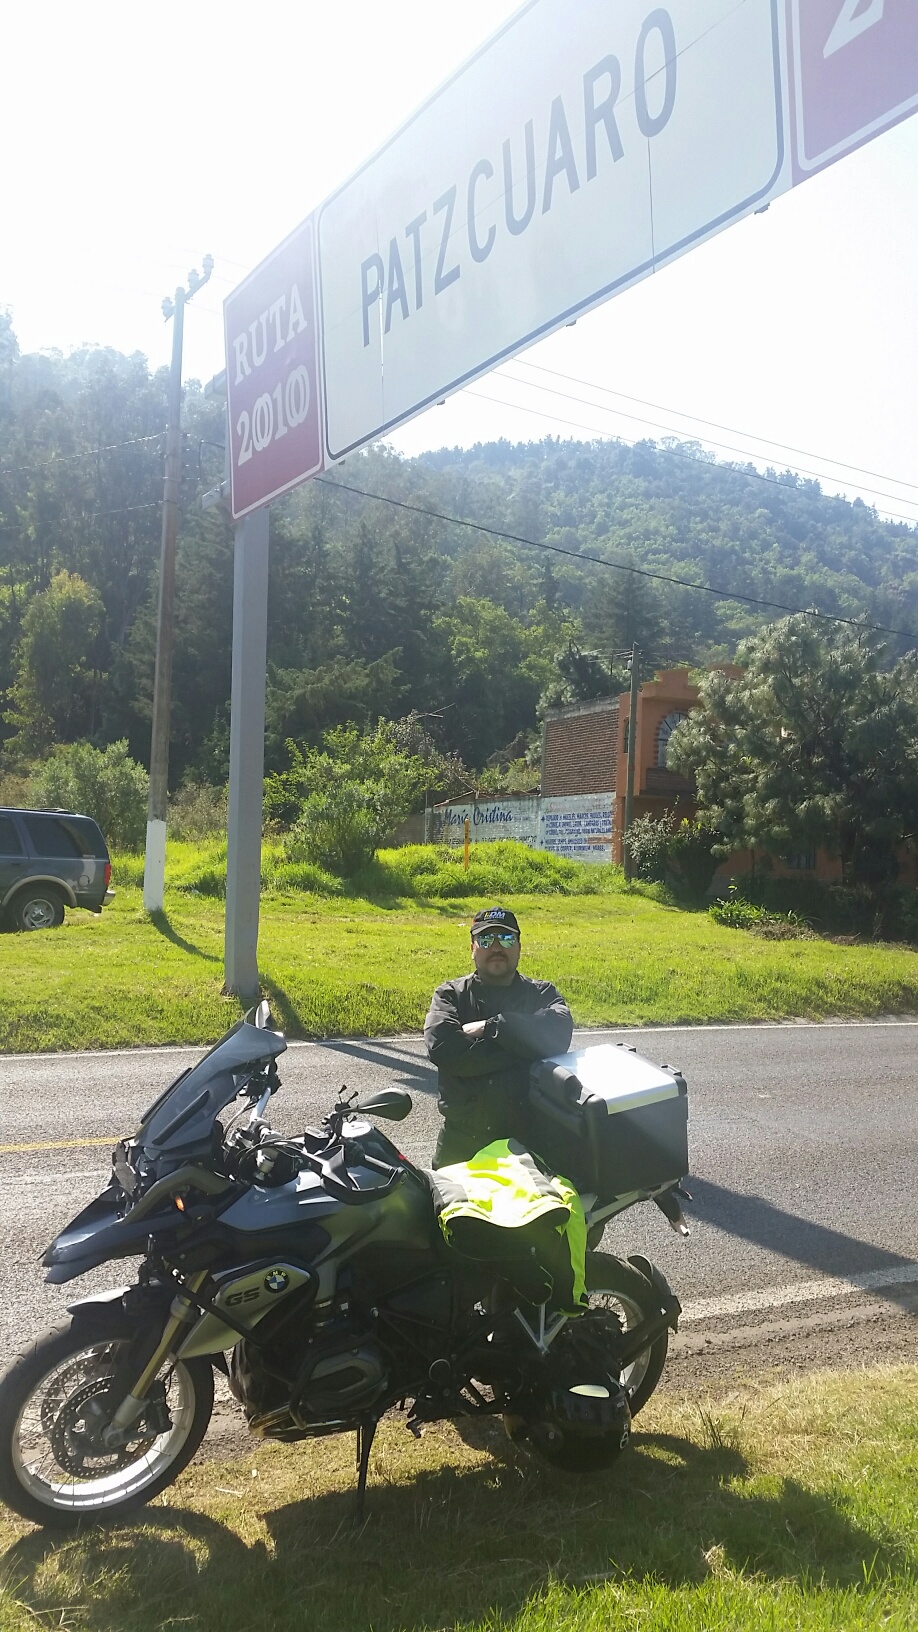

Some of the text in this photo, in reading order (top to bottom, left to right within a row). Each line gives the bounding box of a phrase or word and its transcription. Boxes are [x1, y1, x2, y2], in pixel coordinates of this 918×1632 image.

[361, 8, 678, 348] PATZCUARO
[233, 283, 308, 386] RUTA
[236, 365, 310, 466] 2010
[473, 806, 513, 826] Cristina
[225, 1287, 260, 1307] GS
